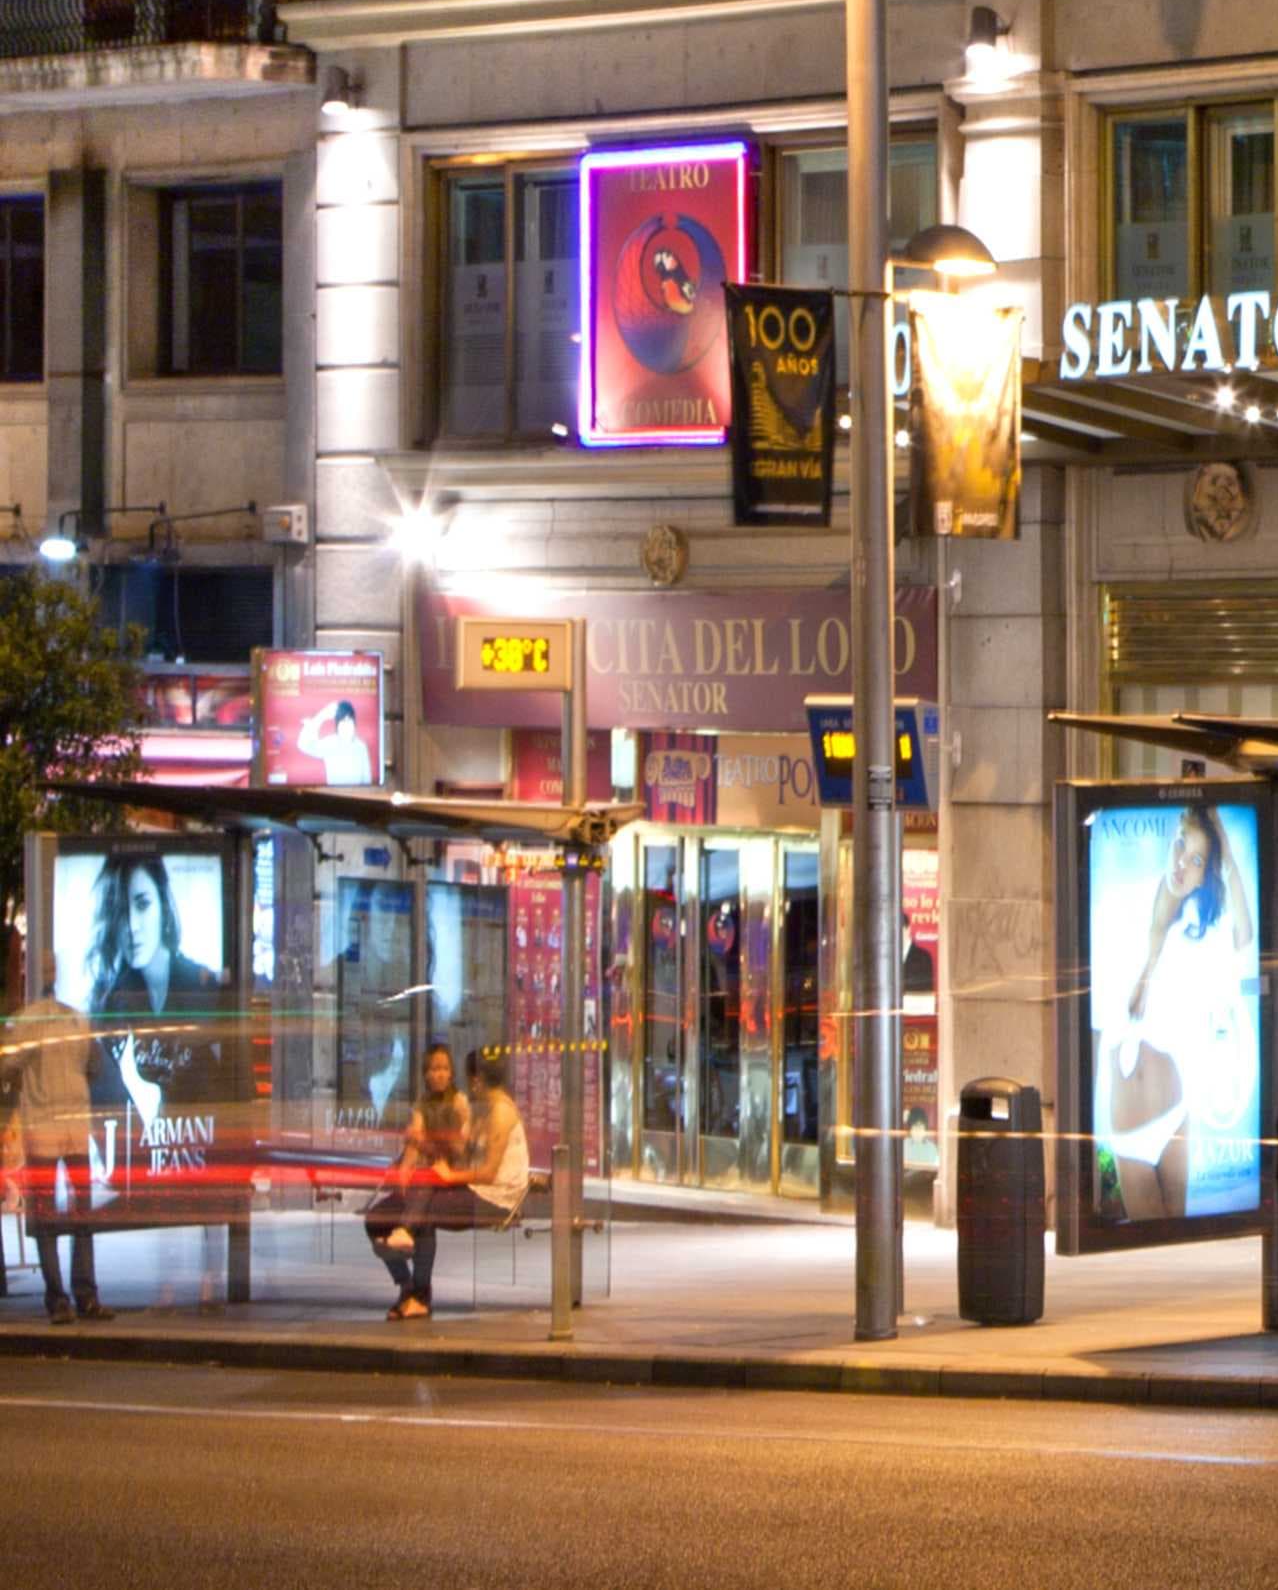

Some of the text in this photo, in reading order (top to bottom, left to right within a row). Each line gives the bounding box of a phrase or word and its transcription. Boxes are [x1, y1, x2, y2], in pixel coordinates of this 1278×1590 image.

[626, 162, 710, 193] TEATRO
[744, 304, 817, 352] 100
[775, 355, 820, 376] AÑOS
[694, 618, 785, 675] DEL
[790, 616, 917, 678] LOO
[616, 681, 728, 715] SENATOR
[139, 1115, 215, 1148] ARMANI
[146, 1147, 208, 1178] JEANS
